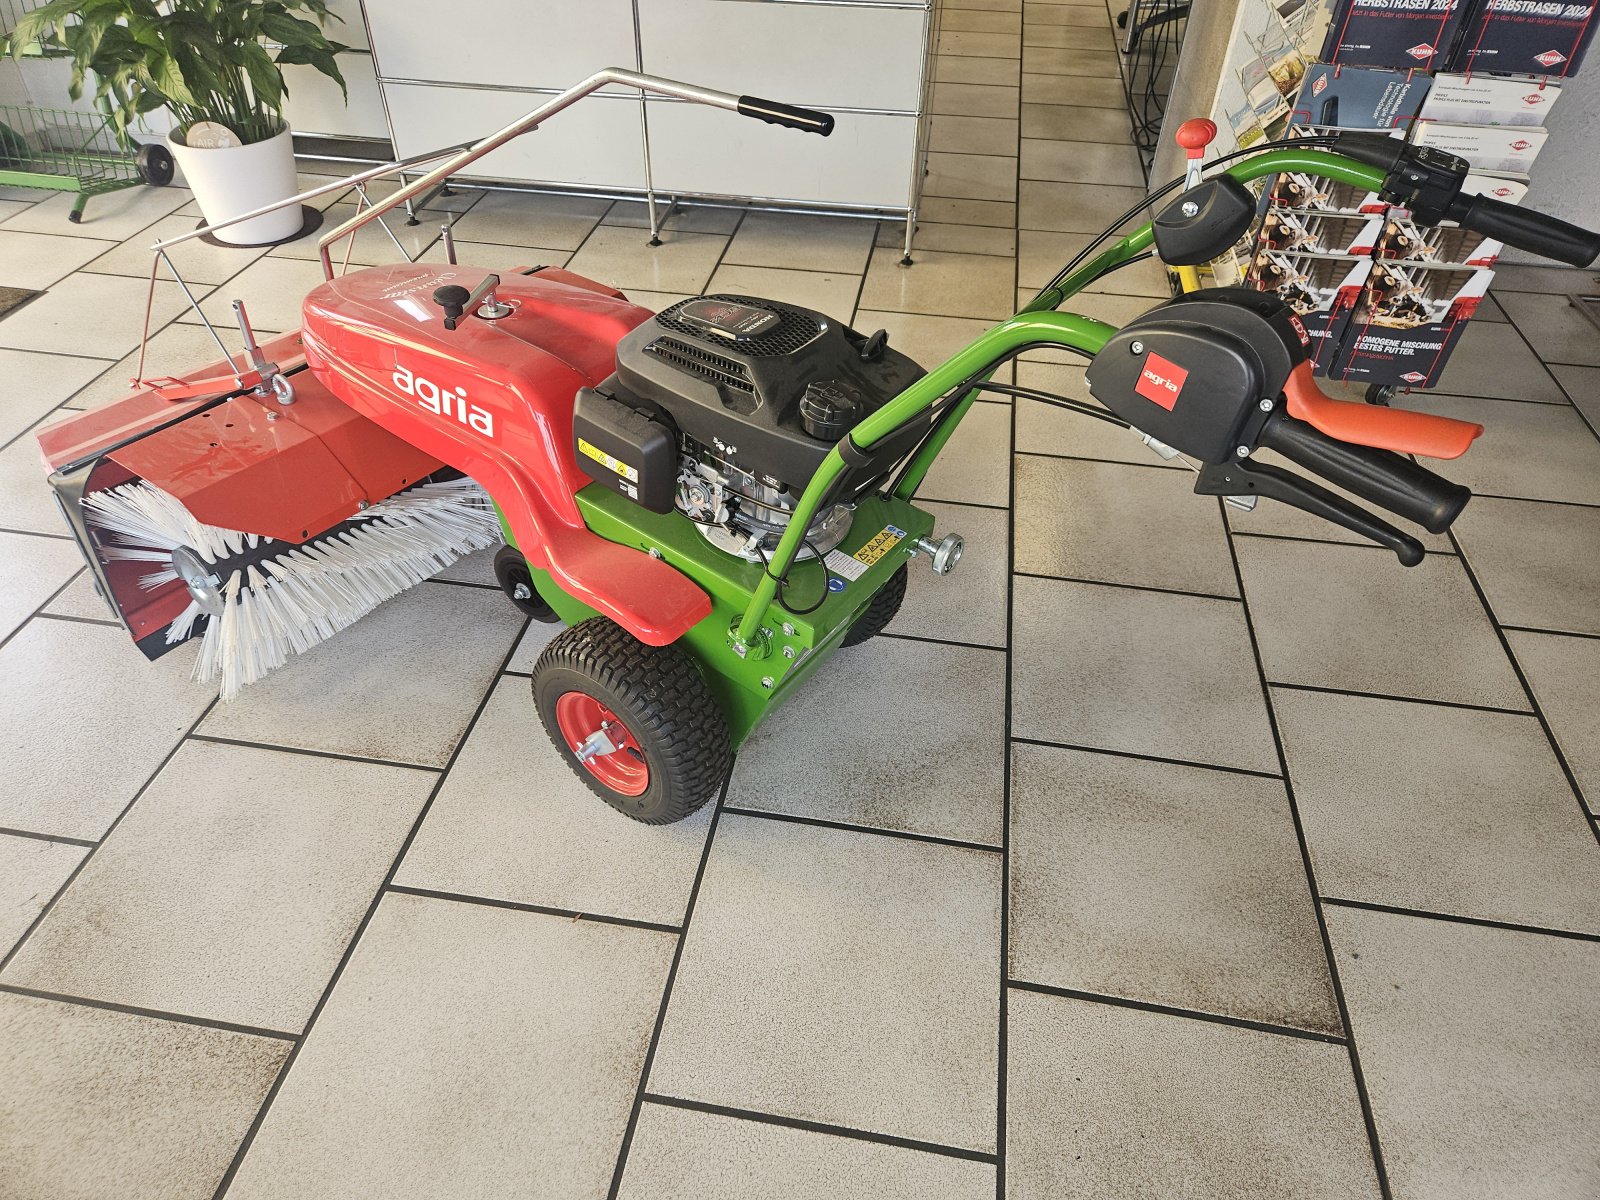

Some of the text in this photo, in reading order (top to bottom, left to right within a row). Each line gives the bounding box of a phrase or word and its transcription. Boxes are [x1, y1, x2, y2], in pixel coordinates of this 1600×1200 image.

[1353, 0, 1458, 10] HERBSTRASEN 2024
[1486, 0, 1592, 18] HERBSTRASEN 2024
[1539, 54, 1562, 62] KUHN
[741, 314, 775, 333] HONDA
[1383, 345, 1415, 356] FUTTER.
[1144, 369, 1179, 393] agria
[392, 364, 494, 438] agria
